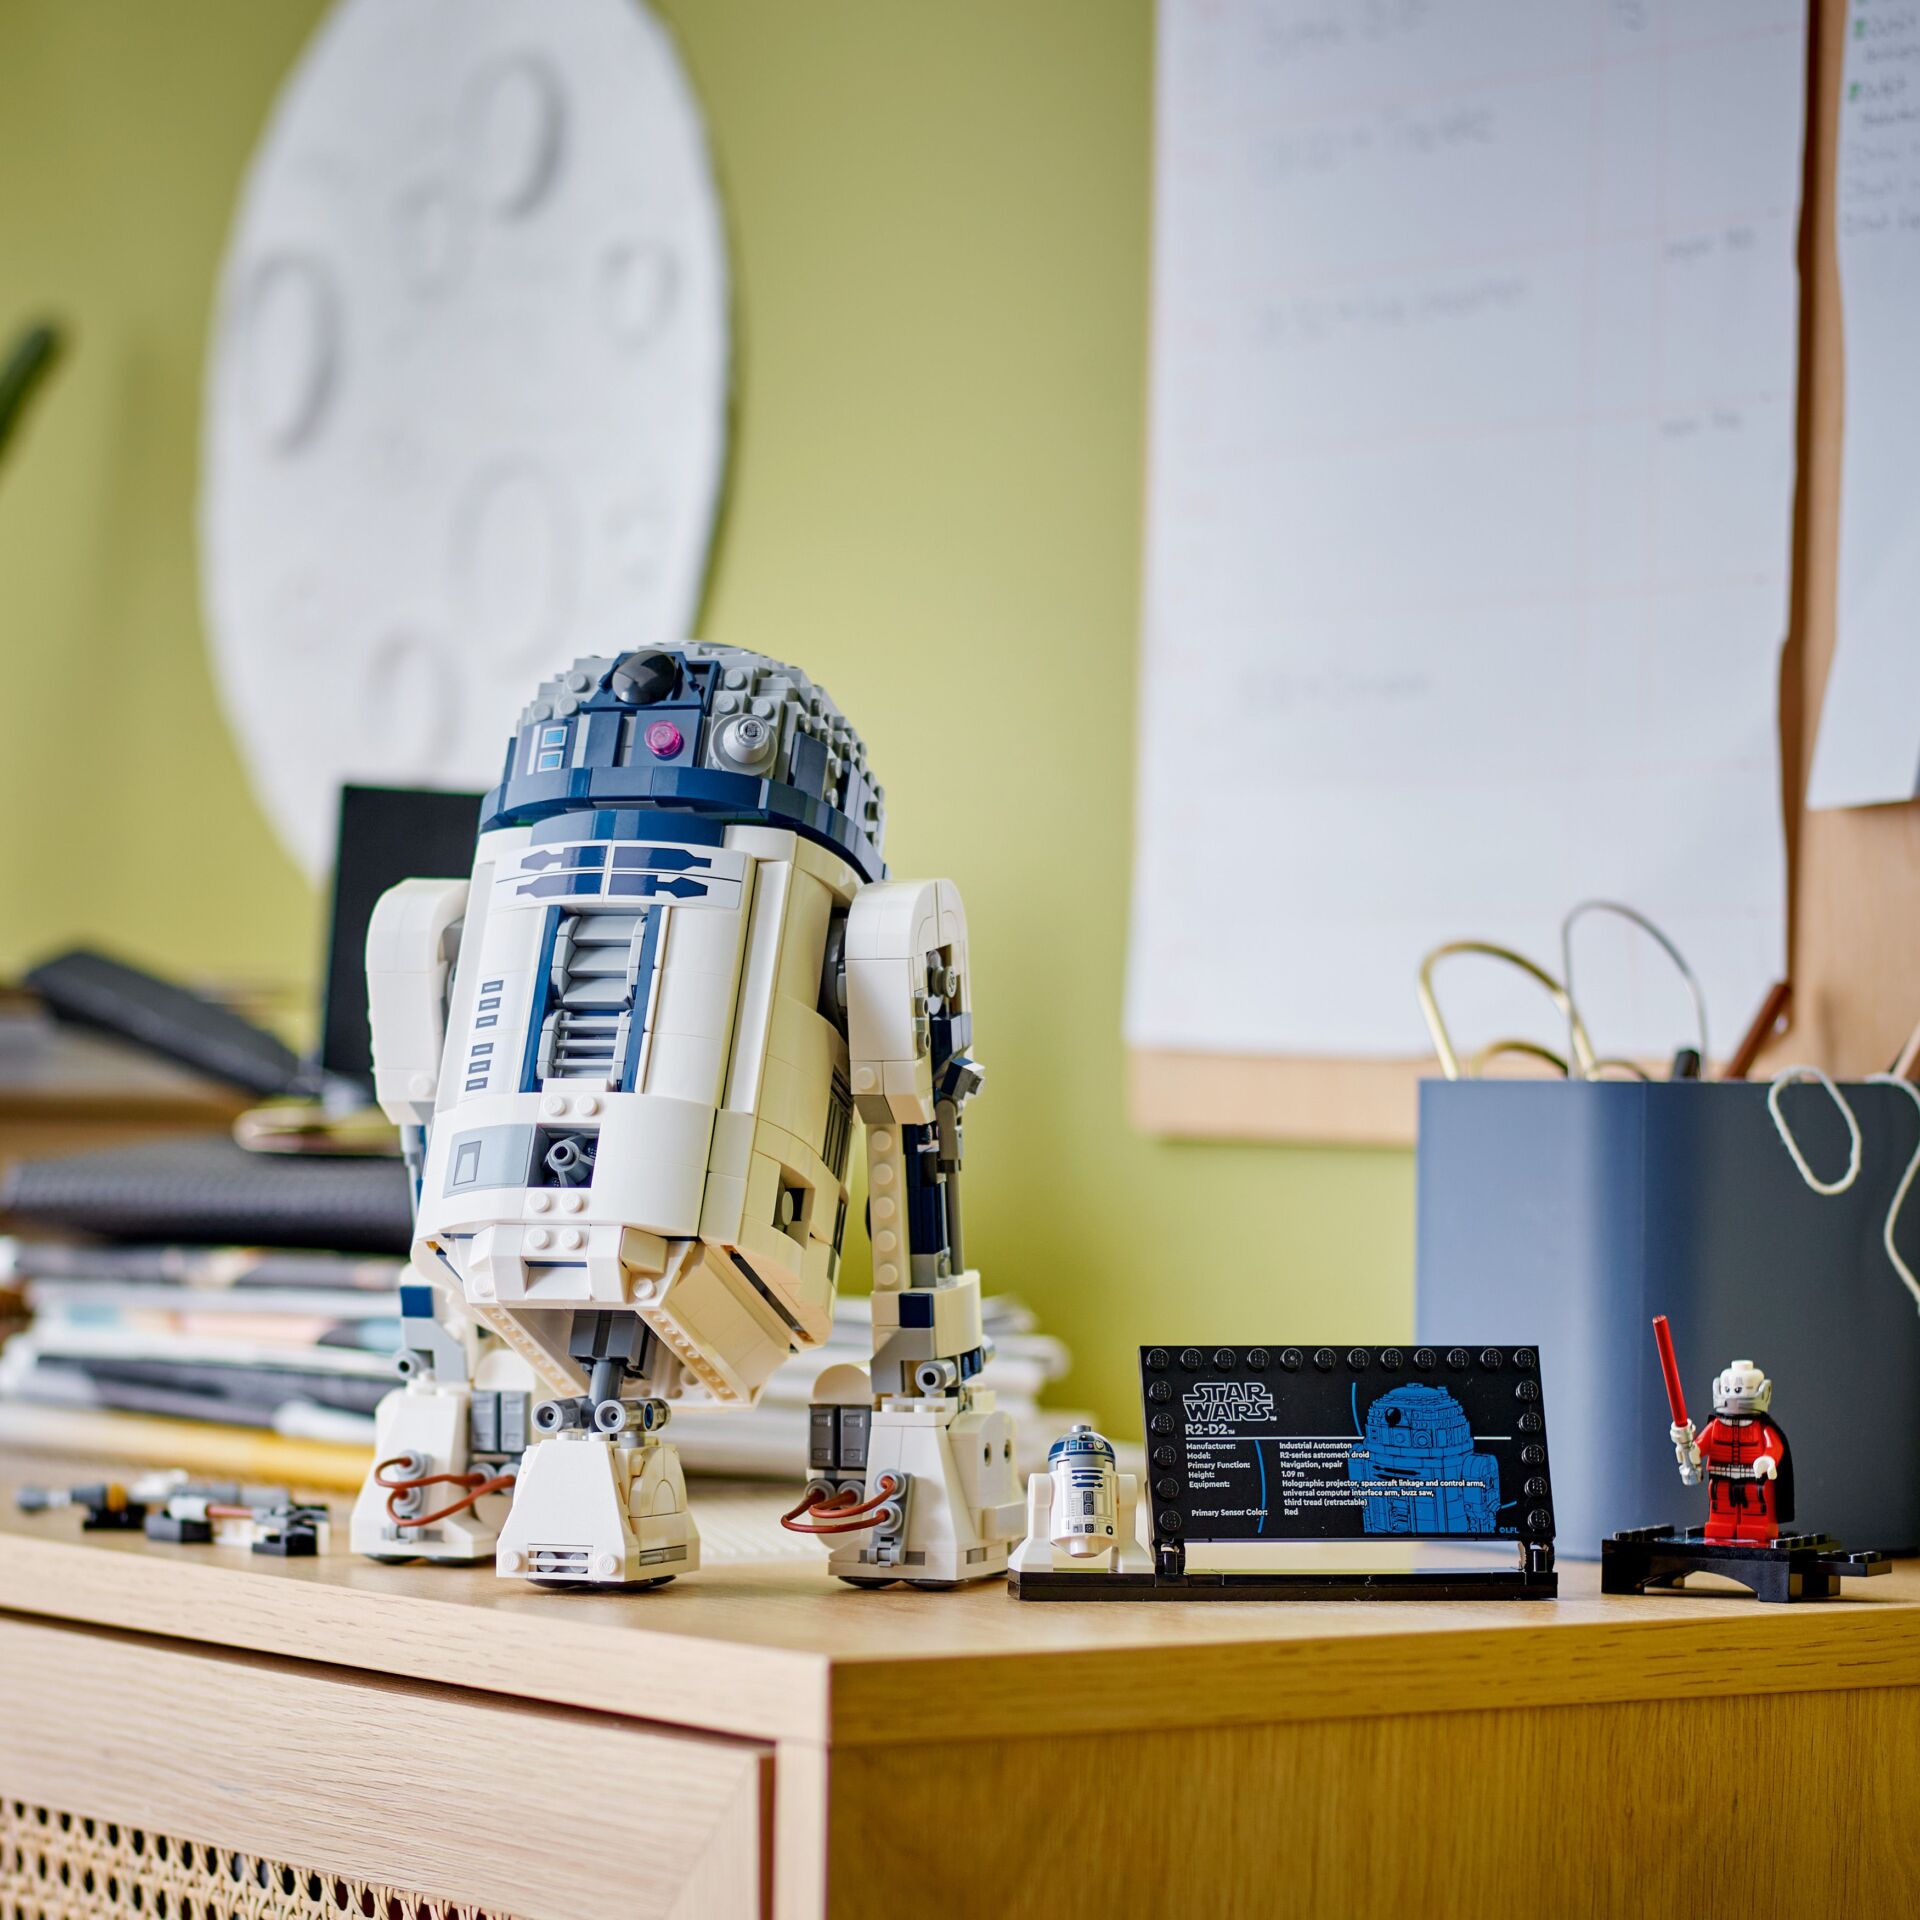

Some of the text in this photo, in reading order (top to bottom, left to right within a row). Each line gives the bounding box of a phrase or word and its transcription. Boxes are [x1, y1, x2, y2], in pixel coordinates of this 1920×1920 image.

[1183, 1382, 1273, 1402] STAR
[1186, 1442, 1236, 1450] Manufacturer:
[1279, 1441, 1312, 1449] Industrial
[1280, 1450, 1370, 1459] R2-series astromech droid
[1187, 1460, 1251, 1470] Primary Function:
[1280, 1460, 1343, 1469] Navigation, repair
[1188, 1471, 1215, 1480] Height:
[1281, 1470, 1296, 1478] 1.09
[1189, 1481, 1230, 1489] Equipment:
[1282, 1479, 1486, 1488] Holographic projector, spacecraft linkage and control arms,
[1283, 1488, 1434, 1498] universal computer interface arm, buzz saw,
[1284, 1498, 1368, 1506] third tread (retractable)
[1191, 1509, 1220, 1517] Primary
[1246, 1508, 1268, 1516] Color:
[1284, 1508, 1299, 1516] Red
